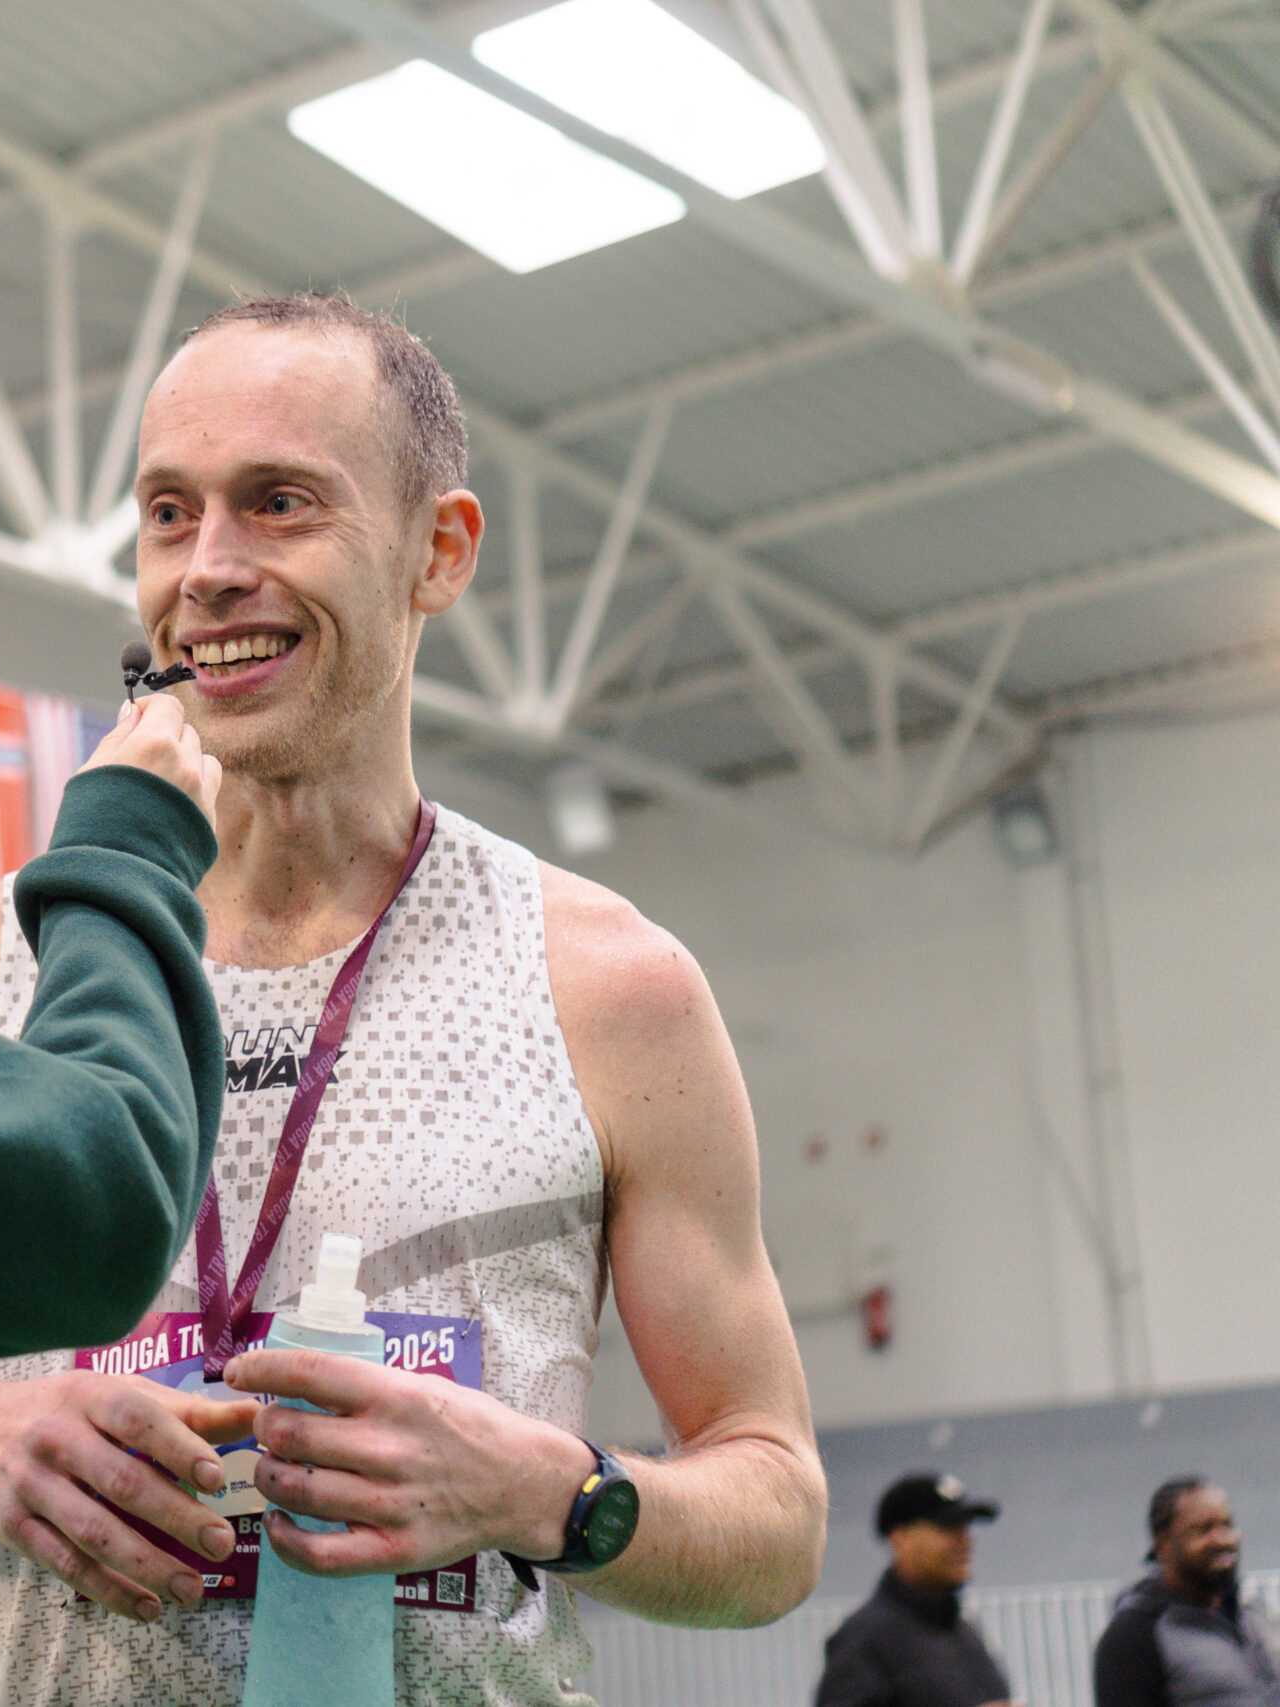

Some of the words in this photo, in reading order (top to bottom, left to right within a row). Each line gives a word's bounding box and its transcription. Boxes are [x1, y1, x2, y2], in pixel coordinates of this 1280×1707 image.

[91, 1333, 170, 1376] VOUGA
[178, 1323, 205, 1359] TR
[385, 1326, 455, 1372] 2025
[238, 1517, 263, 1535] Bo
[234, 1543, 260, 1553] eam
